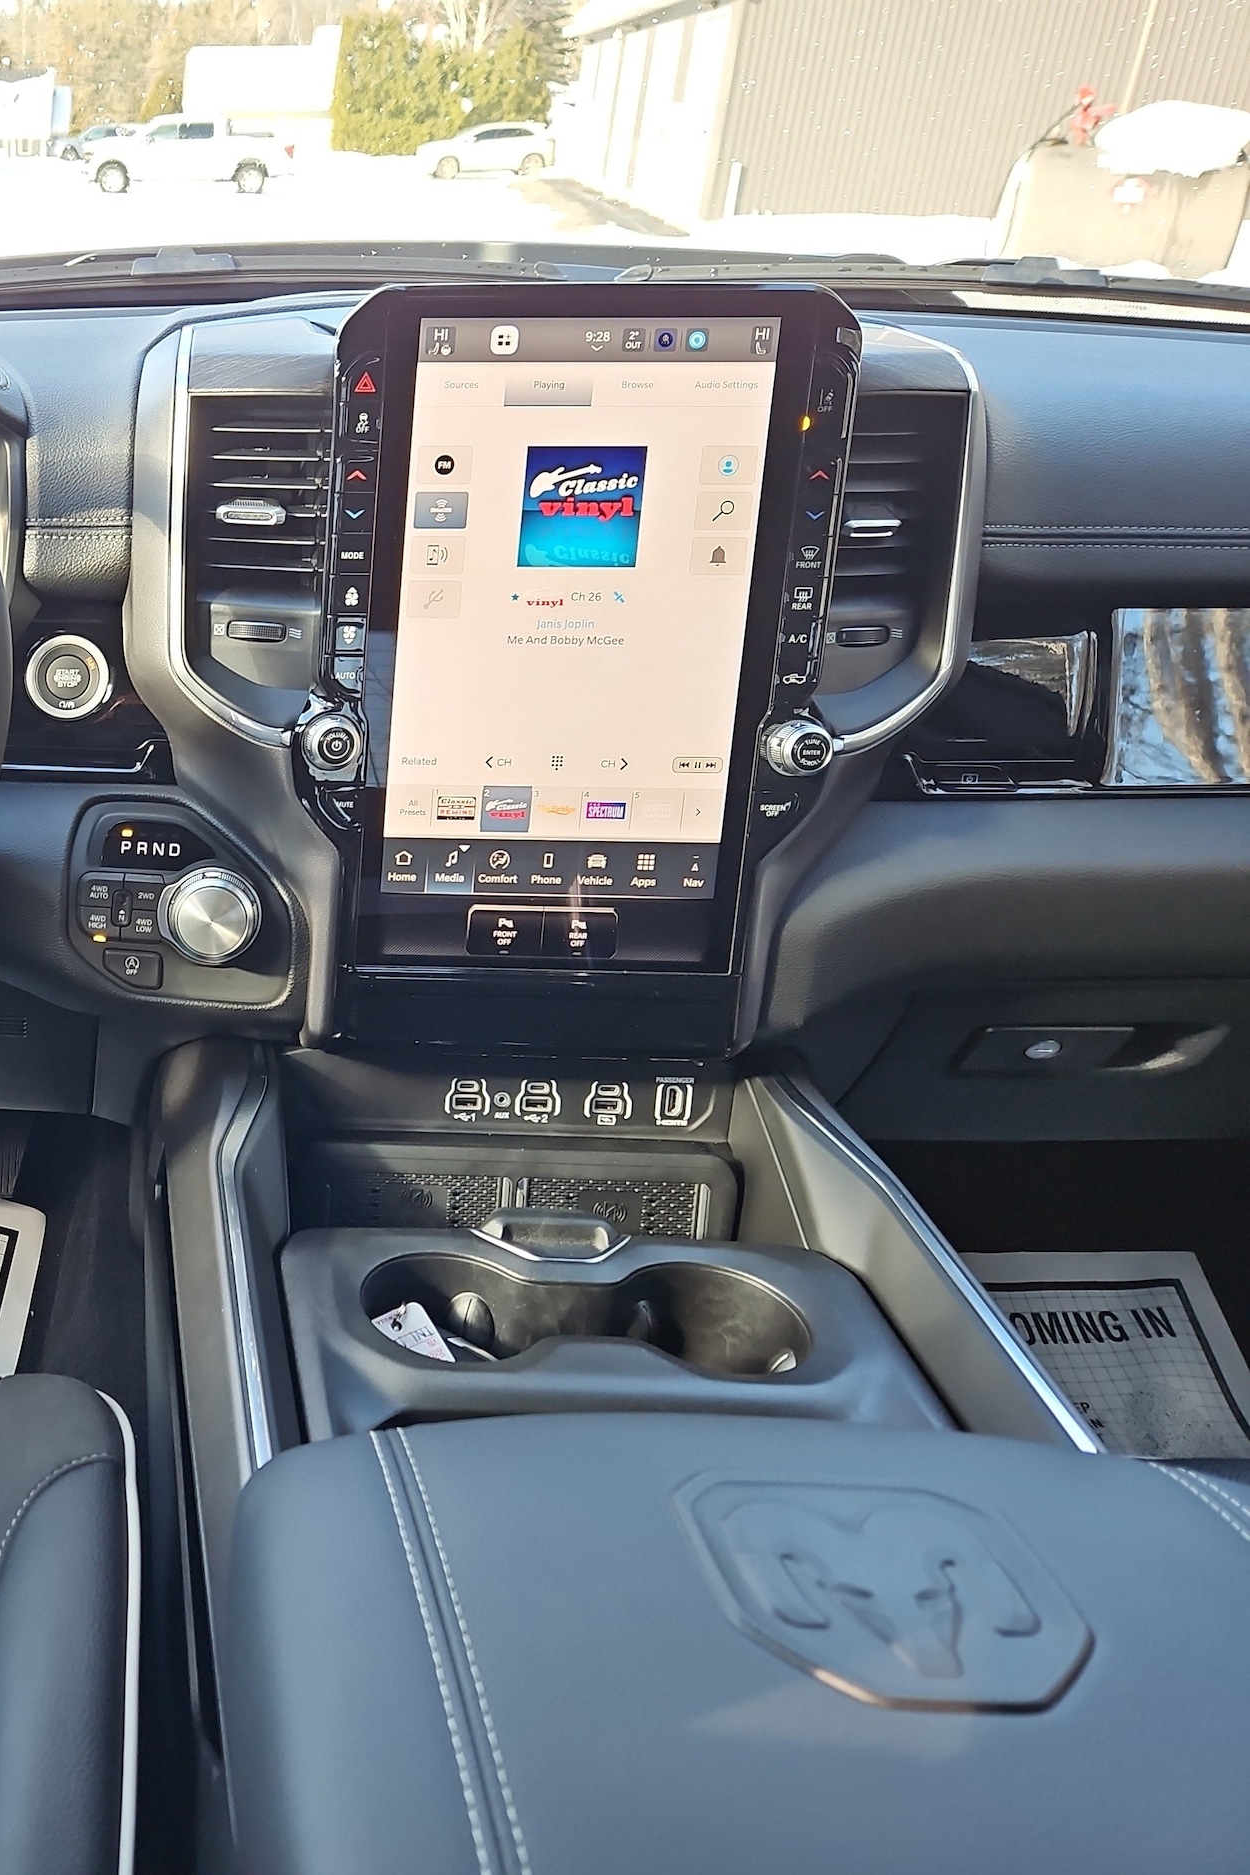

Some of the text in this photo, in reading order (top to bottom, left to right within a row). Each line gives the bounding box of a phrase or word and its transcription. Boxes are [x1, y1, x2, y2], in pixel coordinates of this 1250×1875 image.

[434, 328, 449, 341] HI
[585, 330, 611, 343] 9:28
[754, 327, 771, 341] HI
[625, 341, 642, 350] OUT
[444, 380, 479, 390] Sources
[533, 380, 565, 391] Playing
[621, 380, 654, 390] Browse
[694, 380, 759, 391] Audio Settings
[817, 405, 833, 413] OFF
[355, 425, 370, 434] OFF
[437, 460, 451, 470] FM
[558, 472, 639, 497] Classic
[538, 496, 635, 522] vinyl
[795, 561, 822, 569] FRONT
[526, 598, 564, 608] vinyl
[570, 592, 586, 601] Ch
[588, 592, 602, 601] 26
[791, 602, 812, 611] REAR
[536, 619, 595, 630] Janis Joplin
[507, 635, 625, 647] Me And Bobby McGee
[788, 633, 808, 643] A/C
[53, 674, 82, 682] ENGINE
[335, 672, 356, 680] AUTO
[325, 731, 349, 742] VOLUME
[804, 738, 822, 746] TUNE
[401, 757, 438, 766] Related
[496, 758, 512, 767] CH
[600, 759, 616, 768] CH
[799, 758, 822, 767] SCROLL
[483, 789, 491, 797] 2
[408, 799, 419, 807] All
[495, 801, 528, 811] Classic
[400, 808, 427, 816] Presets
[489, 811, 526, 820] vinyl
[588, 806, 625, 819] SPECTRUM
[387, 872, 417, 882] Home
[434, 873, 465, 884] Media
[477, 873, 518, 884] Comfort
[530, 874, 562, 885] Phone
[576, 874, 613, 886] Vehicle
[630, 876, 657, 888] Apps
[683, 877, 705, 888] Nav
[90, 885, 109, 893] 4WD
[89, 892, 109, 900] AUTO
[137, 892, 155, 900] 2WD
[88, 921, 107, 929] HIGH
[135, 918, 153, 926] 4WD
[135, 925, 152, 933] LOW
[493, 930, 517, 938] FRONT
[568, 932, 588, 940] REAR
[496, 938, 512, 946] OFF
[570, 939, 585, 948] OFF
[125, 968, 138, 976] OFF
[655, 1076, 695, 1084] PASSENGER
[540, 1114, 549, 1123] 2
[1009, 1306, 1177, 1346] OMING IN
